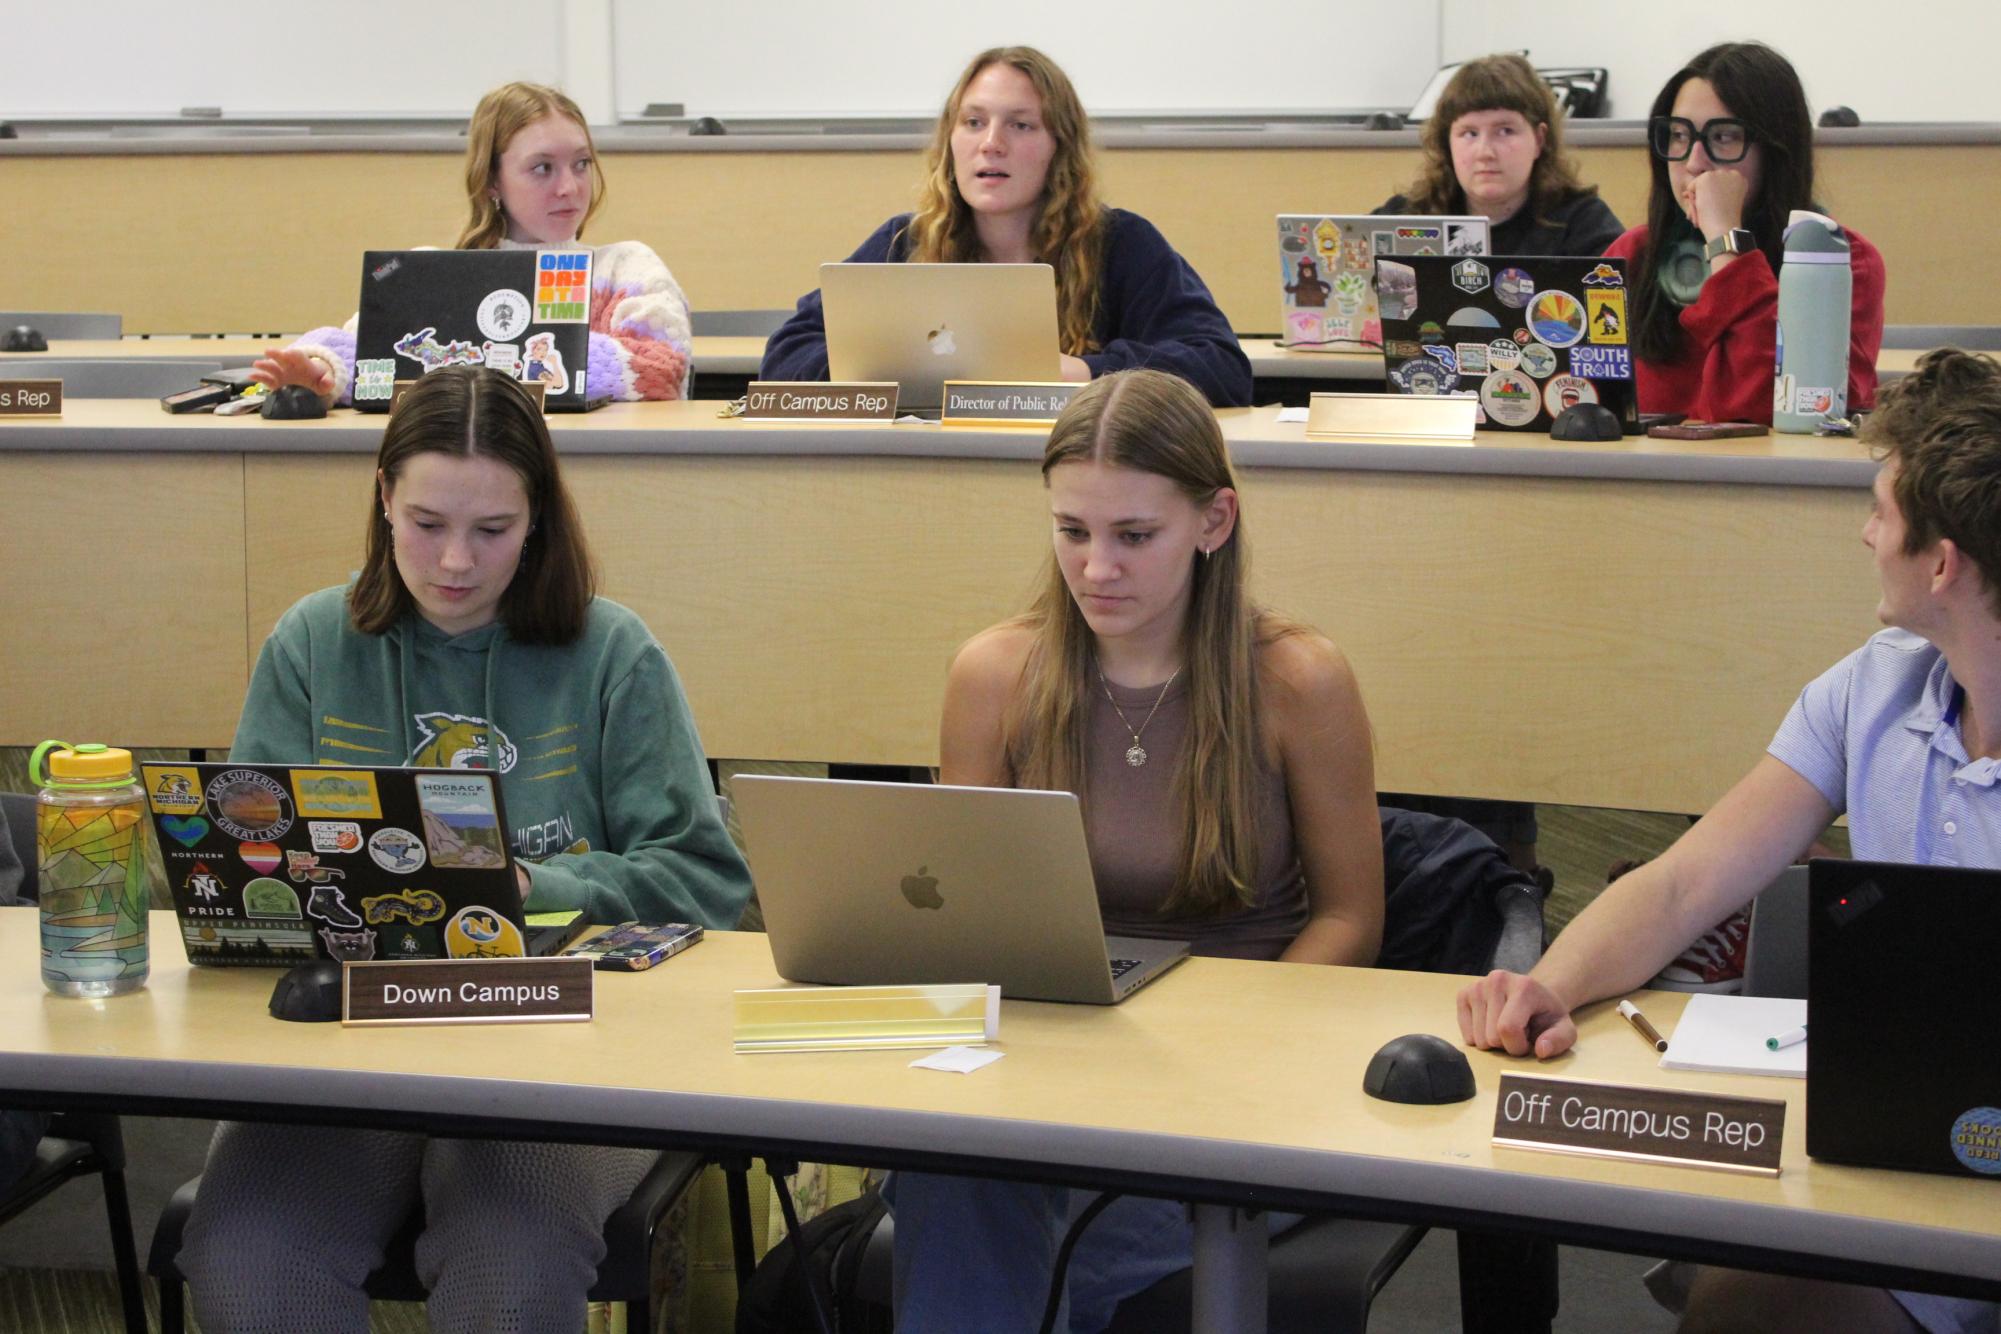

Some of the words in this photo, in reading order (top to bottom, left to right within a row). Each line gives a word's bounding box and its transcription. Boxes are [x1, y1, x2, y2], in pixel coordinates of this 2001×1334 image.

[540, 254, 588, 270] ONE
[540, 271, 586, 287] DAY
[538, 303, 586, 320] TIME
[1489, 348, 1518, 358] WILLY
[1570, 347, 1628, 363] SOUTH
[356, 359, 395, 373] TIME
[18, 389, 50, 408] Rep
[356, 384, 393, 399] NOW
[750, 392, 776, 410] Off
[780, 392, 849, 412] Campus
[855, 394, 888, 413] Rep
[950, 395, 996, 410] Director
[998, 395, 1011, 410] of
[1013, 396, 1047, 411] Public
[208, 778, 225, 801] LAKE
[227, 771, 287, 801] SUPERIOR
[423, 784, 486, 792] HOGBACK
[217, 817, 256, 840] GREAT
[260, 818, 290, 840] LAKES
[188, 907, 236, 916] PRIDE
[384, 984, 452, 1004] Down
[459, 982, 560, 1005] Campus
[1504, 1091, 1552, 1124] Off
[1561, 1097, 1690, 1139] Campus
[1704, 1112, 1765, 1151] Rep
[1956, 1134, 2001, 1149] NNED
